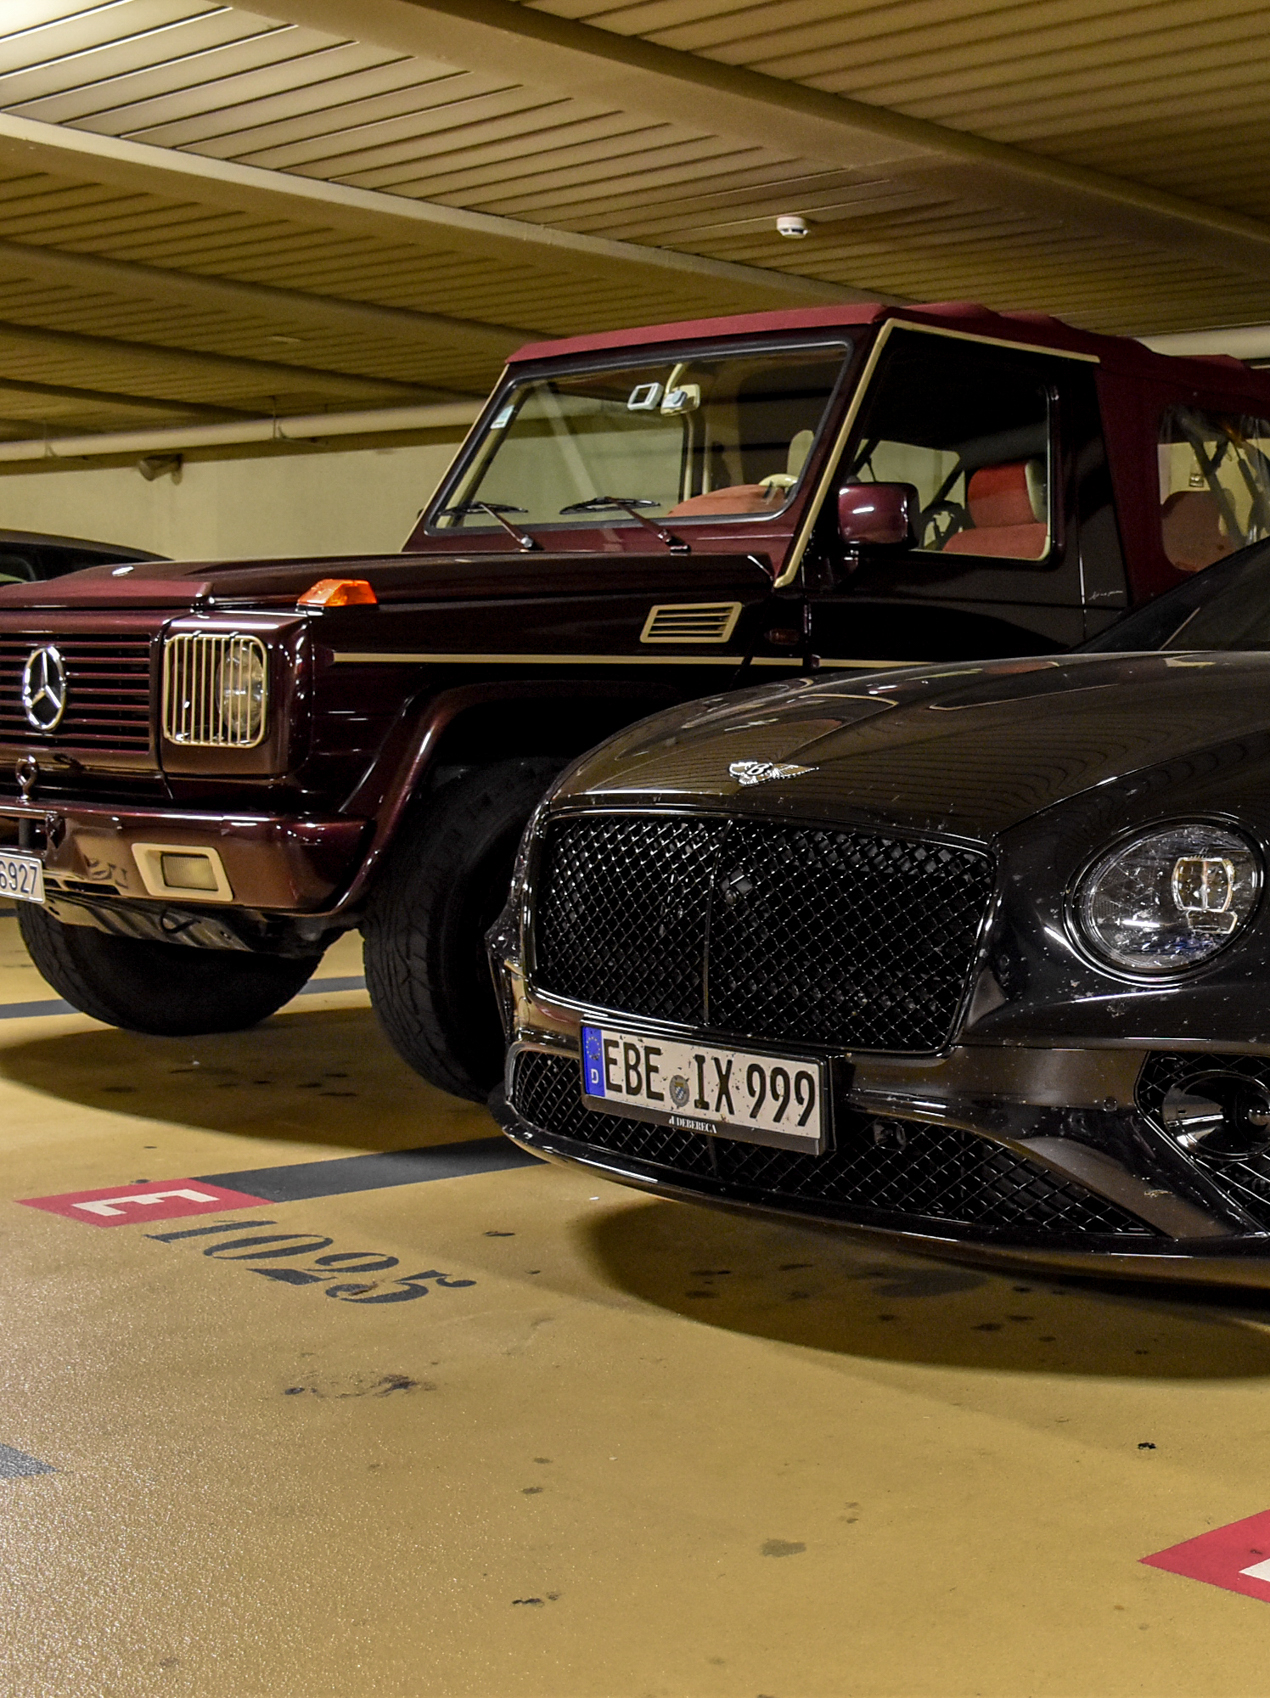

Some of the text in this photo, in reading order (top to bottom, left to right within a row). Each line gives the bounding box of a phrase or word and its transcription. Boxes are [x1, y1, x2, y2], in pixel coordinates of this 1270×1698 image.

[0, 860, 38, 895] 6927
[590, 1068, 599, 1084] D
[603, 1038, 816, 1127] EBE IX 999
[70, 1188, 220, 1217] E
[143, 1219, 477, 1304] 1025
